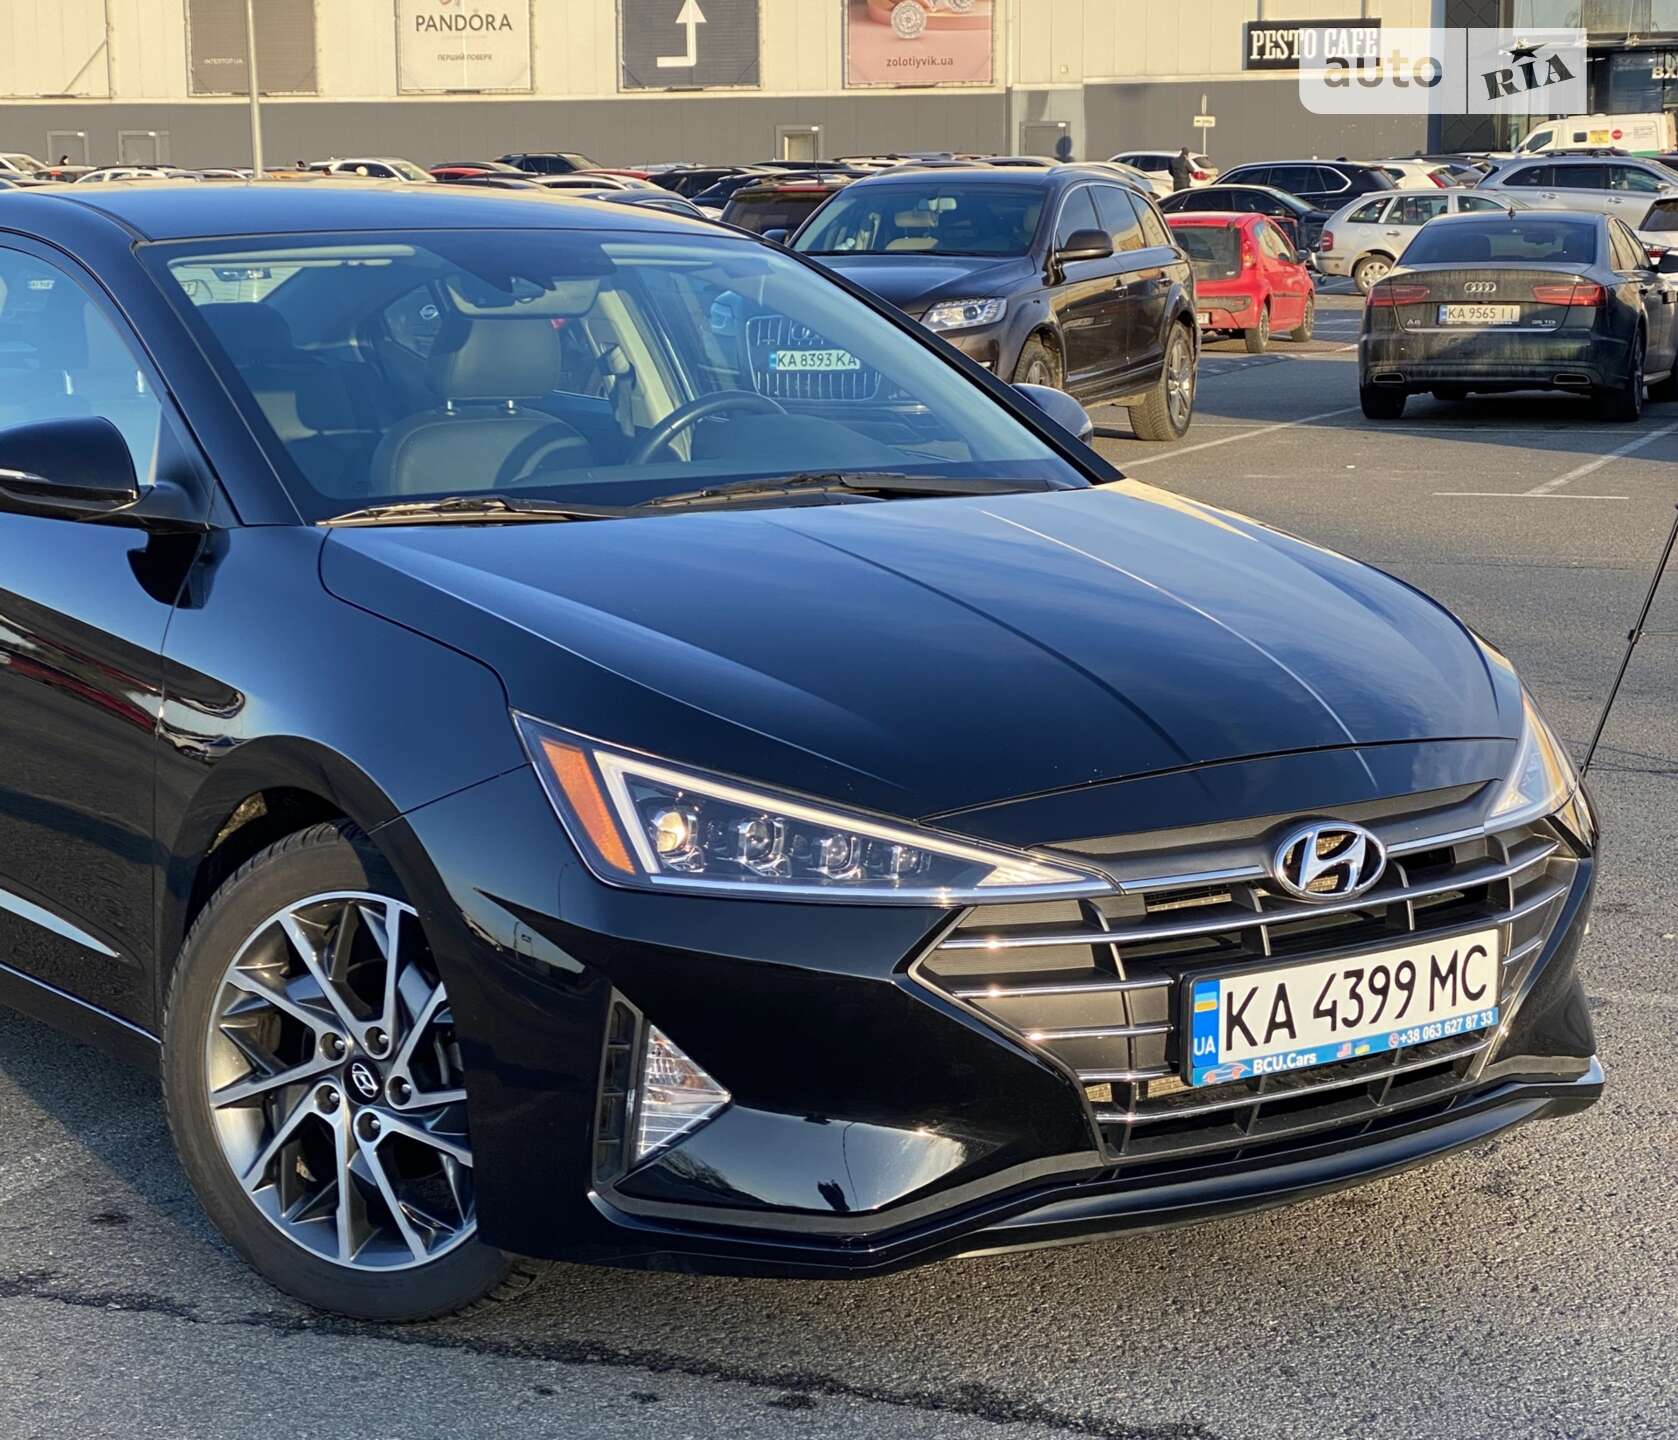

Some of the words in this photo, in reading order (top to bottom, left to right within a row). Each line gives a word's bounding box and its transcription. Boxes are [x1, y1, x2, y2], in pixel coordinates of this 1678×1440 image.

[415, 13, 513, 32] PANDORA
[1249, 29, 1317, 60] PESTO
[1324, 27, 1378, 58] CAFE
[886, 56, 954, 69] zolotiyvik.ua
[1469, 308, 1496, 319] 9565
[777, 353, 797, 367] KA
[800, 352, 832, 367] 8393
[1225, 982, 1297, 1051] KA
[1312, 959, 1417, 1032] 4399
[1429, 944, 1488, 1012] MC
[1400, 1028, 1420, 1043] +38
[1422, 1023, 1441, 1039] 063
[1444, 1018, 1463, 1034] 627
[1465, 1014, 1478, 1029] 87
[1480, 1010, 1493, 1025] 33
[1193, 1035, 1216, 1056] UA
[1253, 1052, 1317, 1075] BCU.Cars
